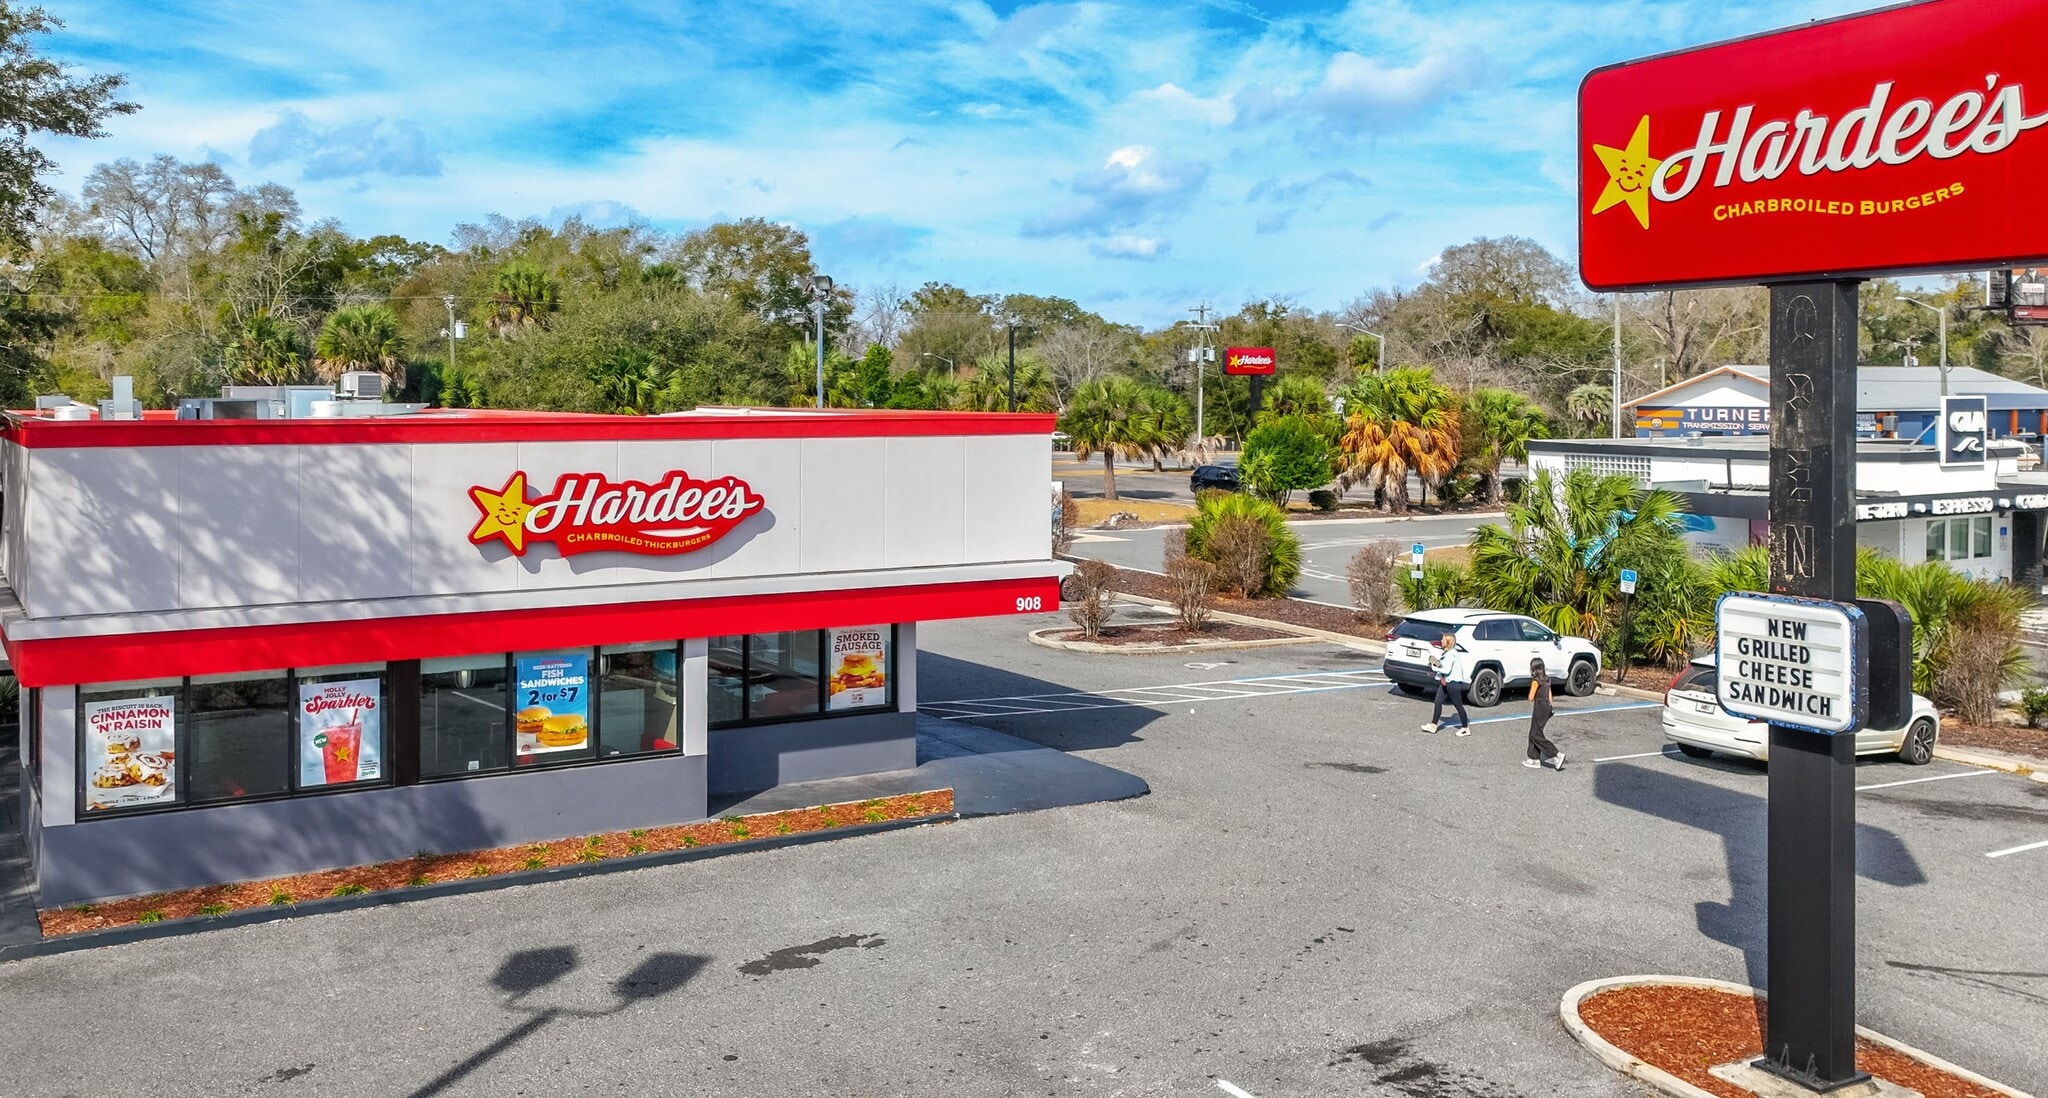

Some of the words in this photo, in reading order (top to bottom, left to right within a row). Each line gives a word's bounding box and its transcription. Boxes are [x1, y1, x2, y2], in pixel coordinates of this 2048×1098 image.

[1651, 73, 2048, 202] Hardee's
[1238, 354, 1273, 366] Hardee's
[1682, 421, 1745, 430] TRANSMISSION
[525, 476, 760, 533] Hardee's
[1932, 497, 1994, 514] ESPRESSO
[567, 533, 642, 547] CHARBROILED
[643, 533, 711, 549] THICKBURGERS
[1016, 596, 1041, 611] 908
[1768, 618, 1807, 641] NEW
[836, 632, 880, 644] SMOKED
[834, 641, 882, 653] SAUSAGE
[1737, 637, 1810, 665] GRILLED
[541, 669, 564, 679] FISH
[1739, 660, 1813, 689] CHEESE
[520, 676, 584, 689] SANDWICHES
[305, 693, 376, 714] Sparkler
[528, 690, 540, 706] 2
[542, 692, 557, 702] for
[560, 686, 579, 702] $7
[1729, 681, 1831, 717] SANDWICH
[91, 709, 170, 724] CINNAMON
[97, 706, 110, 714] THE
[114, 719, 162, 731] RAISIN
[314, 737, 327, 746] NEW
